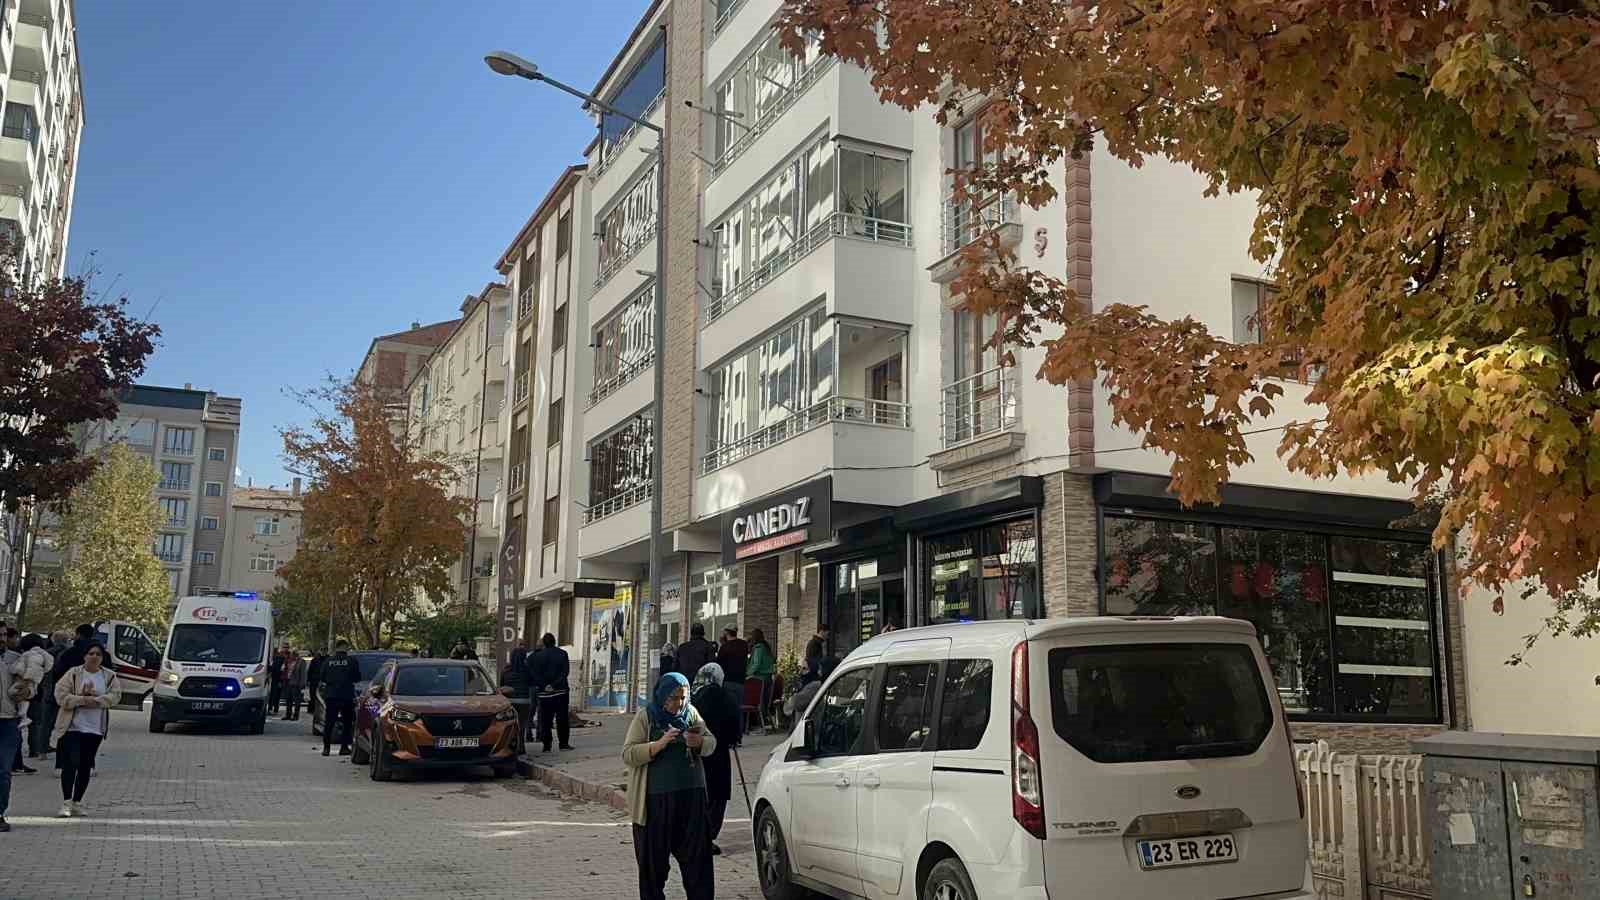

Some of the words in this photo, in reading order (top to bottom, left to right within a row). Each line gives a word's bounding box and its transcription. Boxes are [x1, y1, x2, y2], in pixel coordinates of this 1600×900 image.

[1052, 821, 1117, 829] TOURNEO
[1152, 843, 1173, 862] 23
[1177, 840, 1201, 861] ER
[1204, 838, 1233, 858] 229
